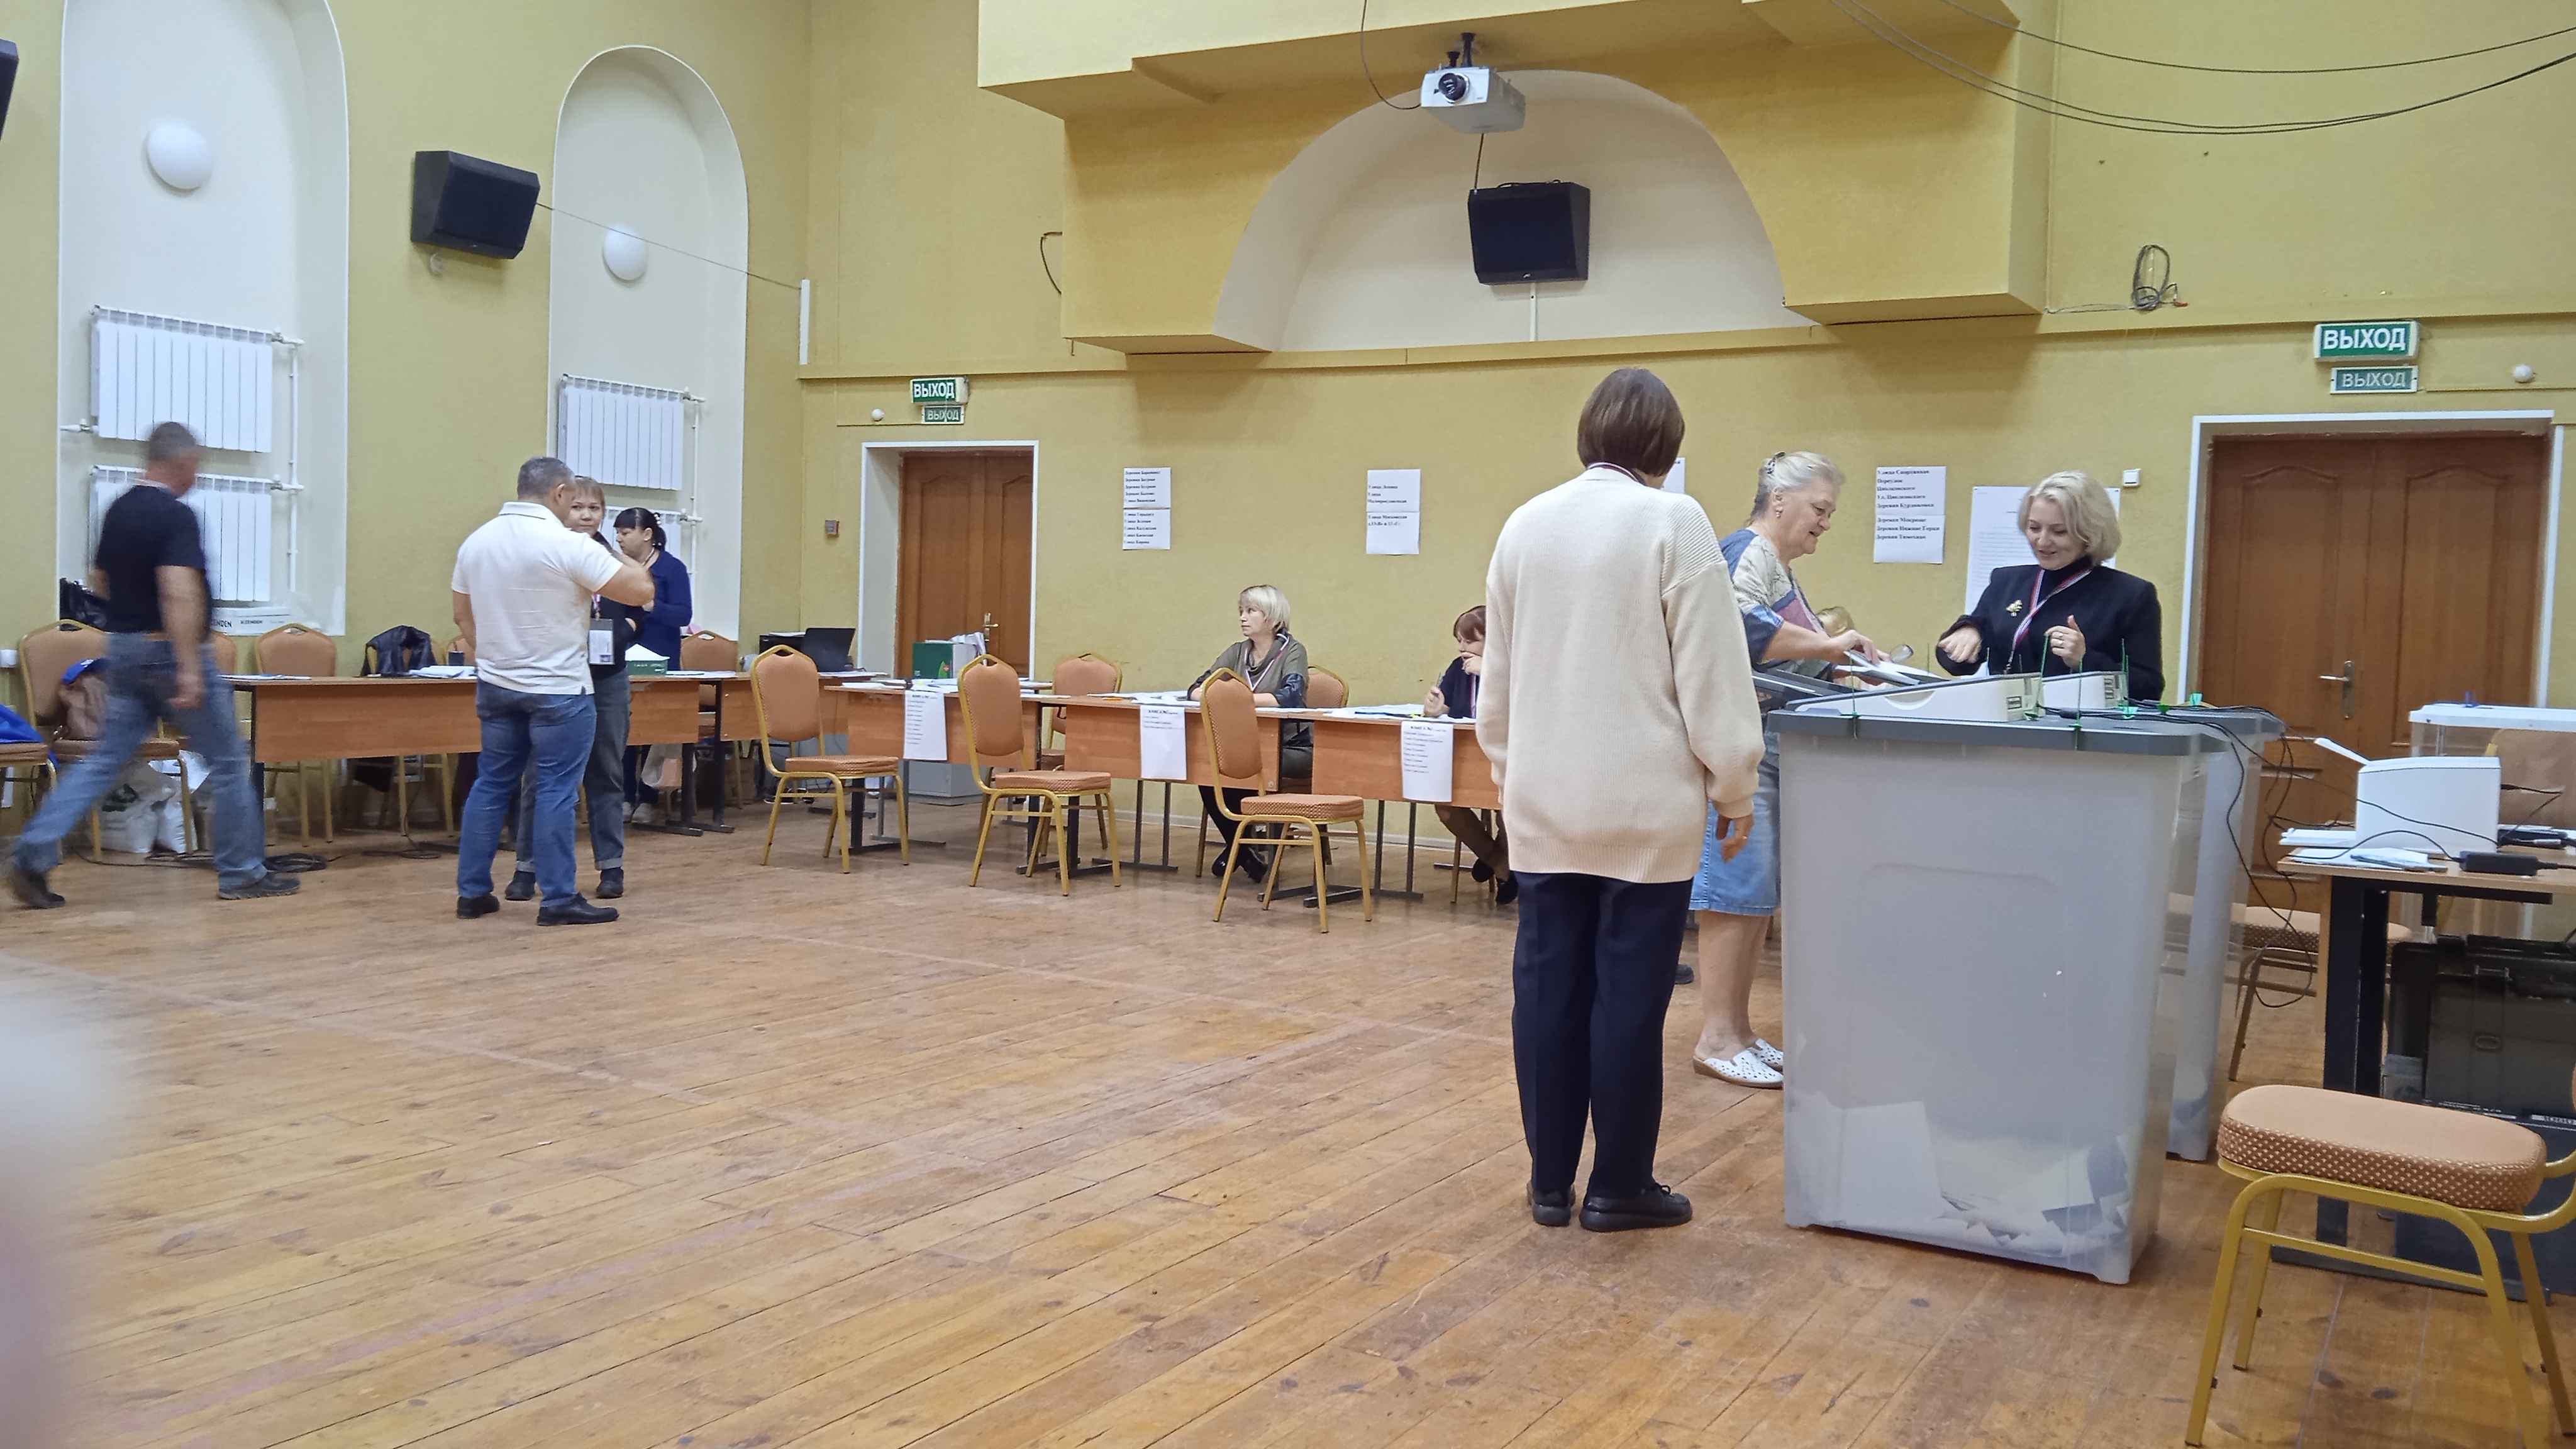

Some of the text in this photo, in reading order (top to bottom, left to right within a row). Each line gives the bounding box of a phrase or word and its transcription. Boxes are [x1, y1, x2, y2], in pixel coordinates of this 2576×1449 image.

[2323, 327, 2406, 351] ВЫХОД
[2342, 372, 2406, 387] ВЫХОД
[914, 382, 955, 399] ВЫХОД
[927, 409, 959, 421] ВЫХОД
